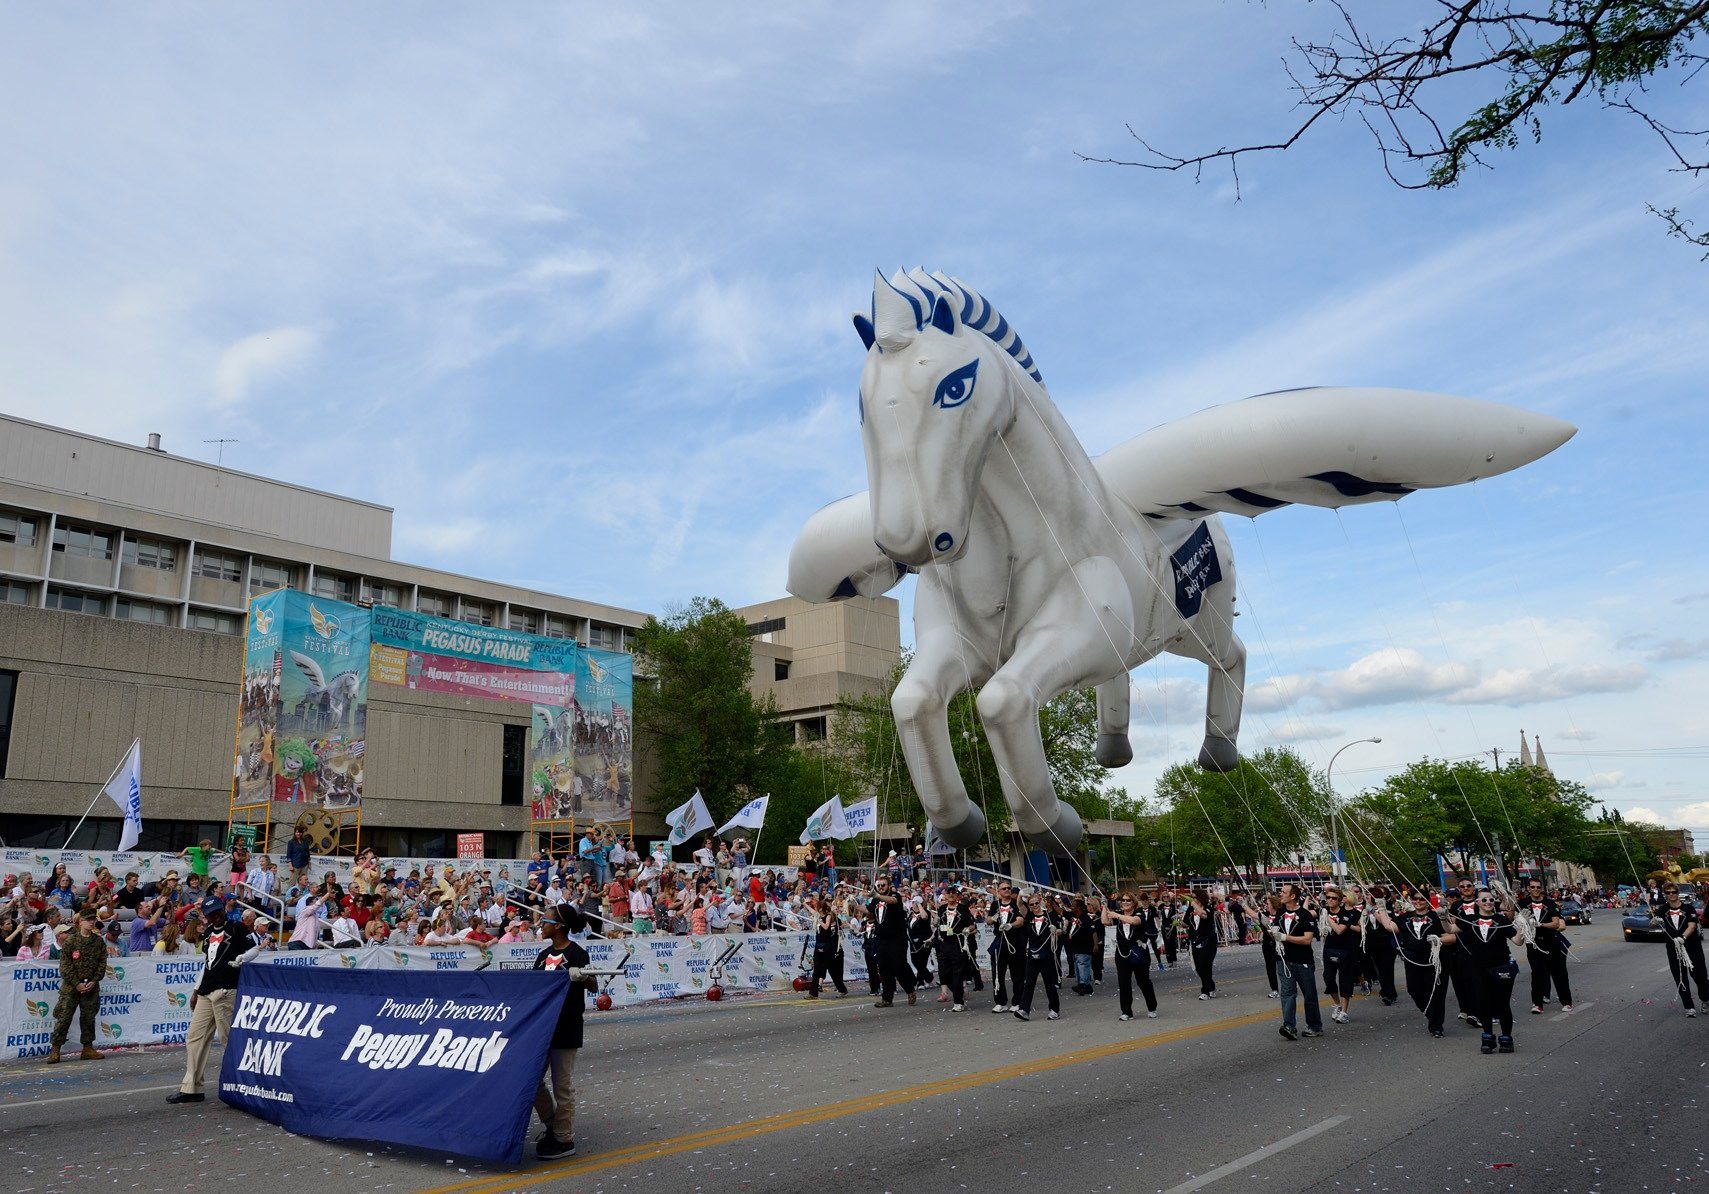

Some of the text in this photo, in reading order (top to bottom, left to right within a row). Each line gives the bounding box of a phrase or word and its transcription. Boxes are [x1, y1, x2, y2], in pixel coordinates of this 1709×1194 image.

[375, 614, 421, 632] REPUBLIC
[382, 627, 409, 641] BANK
[427, 620, 533, 645] KENTUCKY DERBY FESTIVAL
[304, 640, 350, 656] FESTIVAL
[422, 628, 530, 663] PEGASUS PARADE
[534, 641, 576, 657] REPUBLIC
[540, 653, 565, 666] BANK
[427, 666, 453, 682] Now,
[455, 670, 488, 687] That's
[490, 675, 570, 697] Entertainment!
[460, 851, 484, 859] ORANGE
[586, 944, 613, 953] REPUBLIC
[651, 941, 678, 950] REPUBLIC
[273, 957, 319, 966] REPUBLIC
[430, 951, 467, 960] REPUBLIC
[436, 961, 459, 970] BANK
[502, 962, 525, 970] ATTENTION
[623, 963, 645, 971] EPUBLIC
[686, 959, 710, 967] REPUBLIC
[13, 968, 62, 980] REPUBL
[165, 974, 196, 984] BANK
[24, 981, 60, 992] BANK
[652, 983, 680, 992] REPUBLIC
[99, 994, 142, 1006] EPUBLIC
[101, 1006, 130, 1016] BANK
[231, 995, 337, 1039] REPUBLIC
[376, 998, 511, 1025] Proudly Presents
[152, 1022, 190, 1034] REPUB
[7, 1033, 52, 1047] REPUB
[163, 1033, 187, 1044] BAN
[340, 1024, 510, 1073] Peggy Bank
[237, 1037, 293, 1077] BANK
